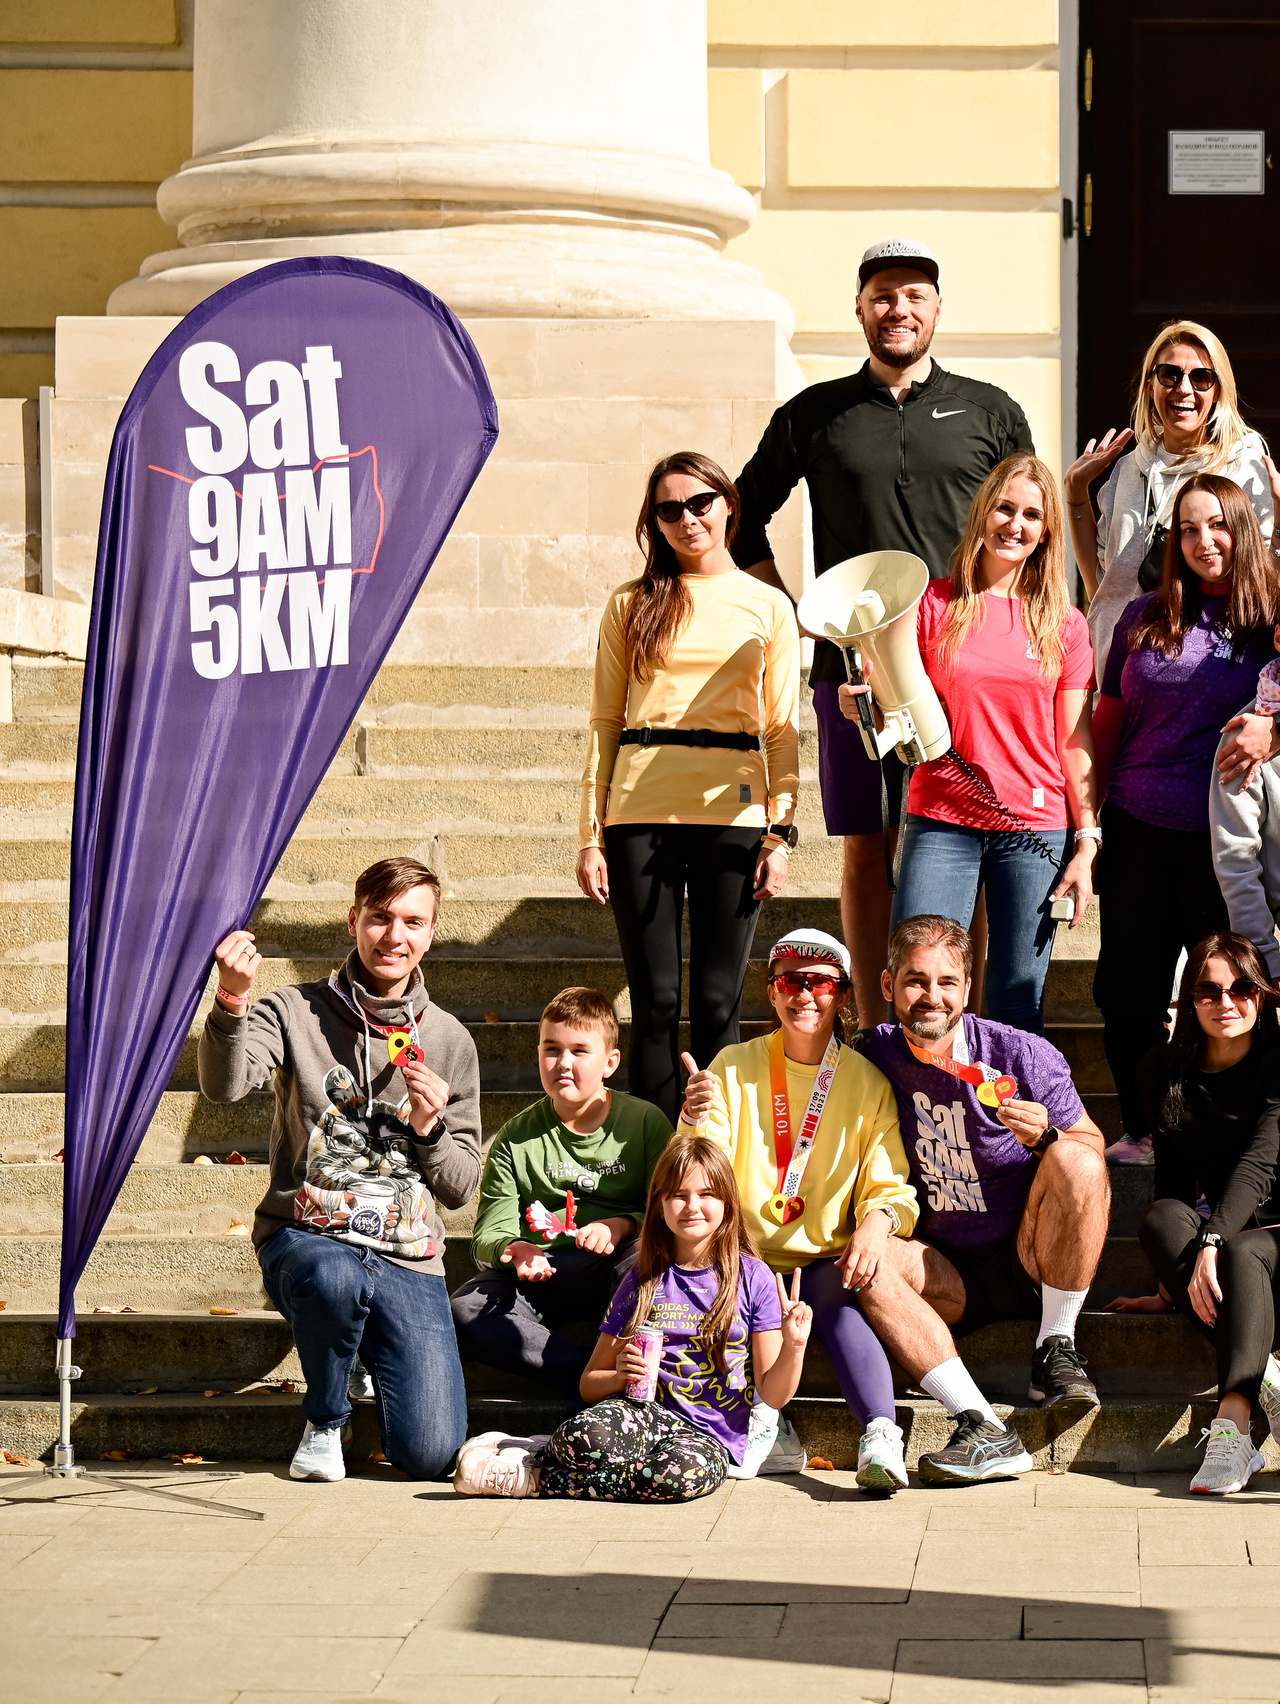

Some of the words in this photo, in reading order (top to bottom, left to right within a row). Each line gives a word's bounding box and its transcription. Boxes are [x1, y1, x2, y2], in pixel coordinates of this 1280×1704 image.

[178, 341, 350, 475] Sat
[187, 466, 352, 578] 9AM
[188, 568, 352, 680] 5KM
[774, 1093, 787, 1116] KM
[808, 1091, 820, 1112] 17/09
[815, 1093, 826, 1114] 2023
[776, 1120, 789, 1137] 10
[912, 1091, 971, 1150] Sat
[545, 1168, 579, 1179] THING
[585, 1163, 626, 1179] HAPPEN
[547, 1162, 553, 1170] I
[915, 1138, 979, 1182] 9AM
[920, 1174, 988, 1213] 5KM
[651, 1302, 690, 1312] ADIDAS
[649, 1321, 677, 1330] TRAIL
